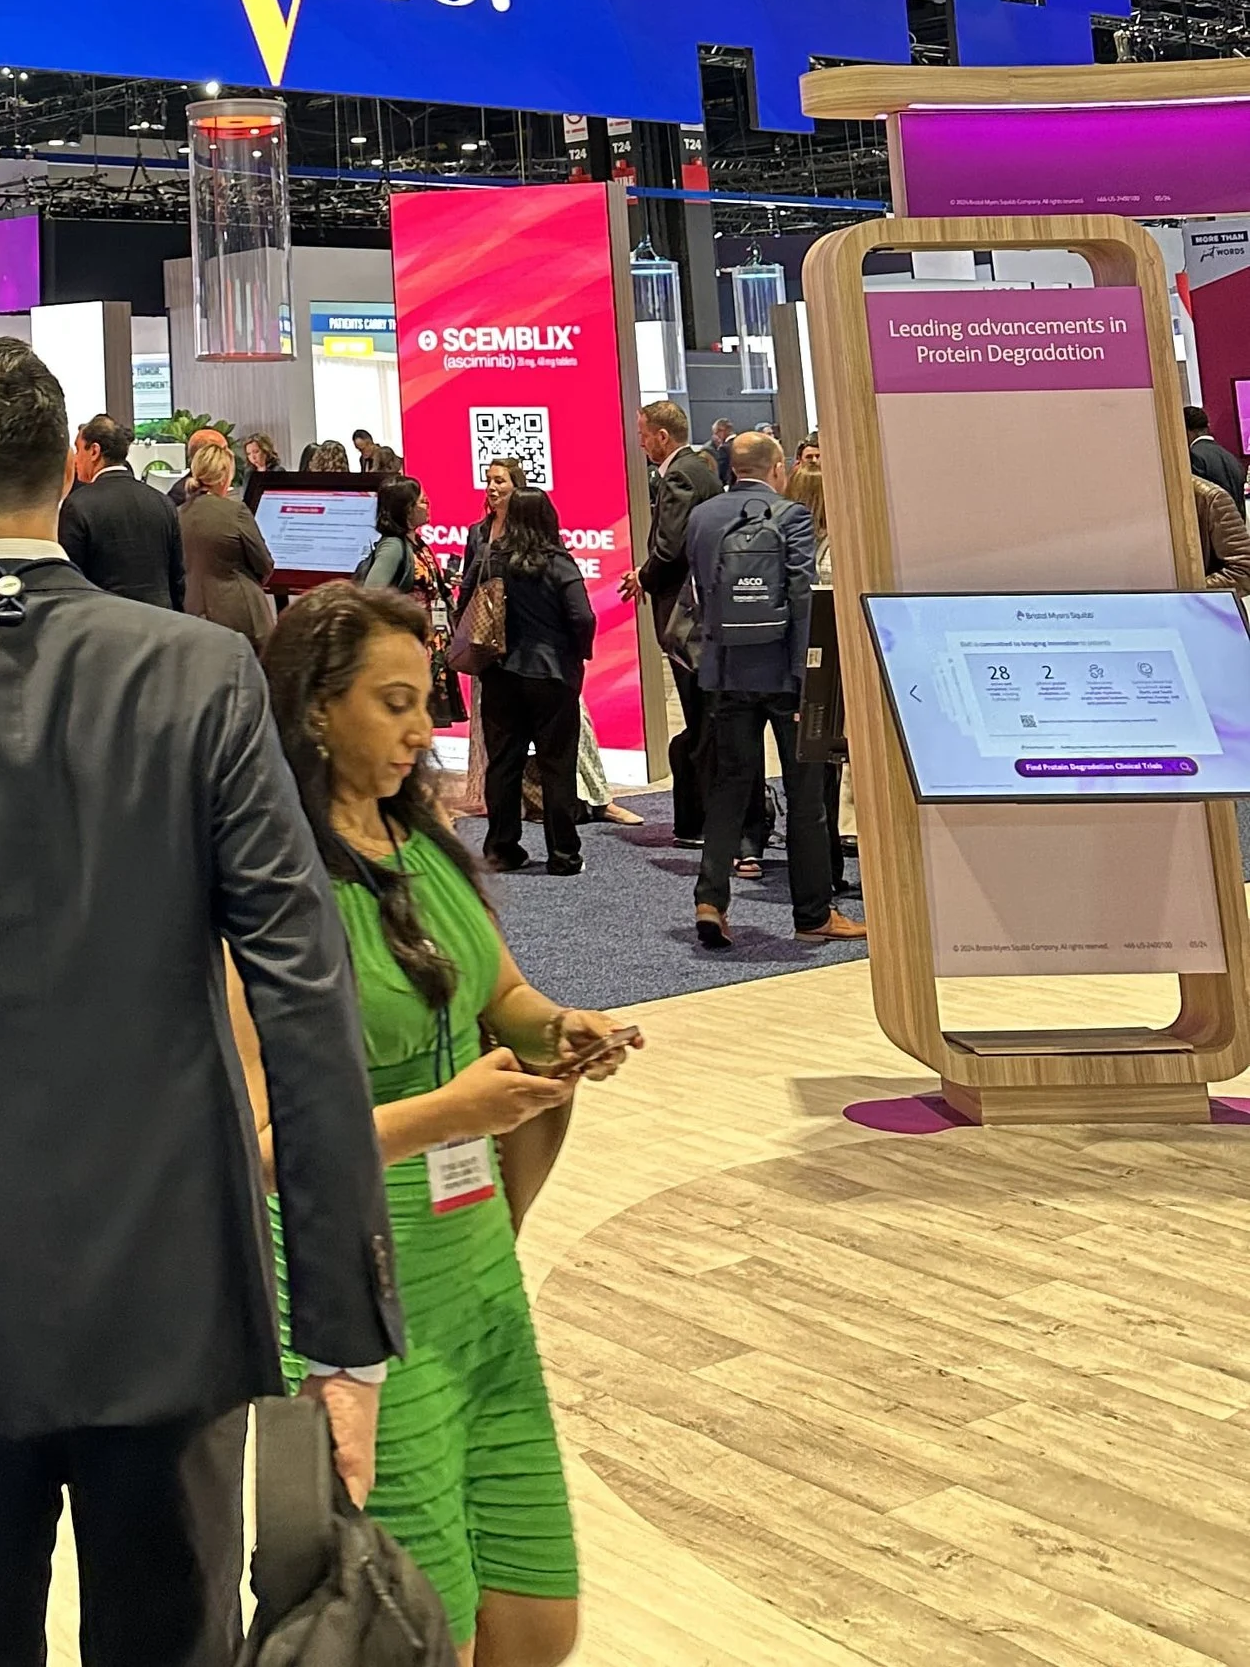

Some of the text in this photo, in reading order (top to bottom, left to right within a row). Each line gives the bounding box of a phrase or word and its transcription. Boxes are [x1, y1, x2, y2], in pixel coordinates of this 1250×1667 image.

[611, 140, 632, 154] T24
[683, 138, 702, 151] T24
[568, 148, 588, 160] T24
[1195, 233, 1244, 243] MORE THAN
[1216, 247, 1245, 256] WORDS
[889, 316, 1127, 341] Leading advancements in
[916, 343, 1105, 366] Protein Degradation
[444, 353, 516, 371] (asciminib)
[559, 529, 615, 550] CODE
[738, 577, 763, 586] ASCO
[987, 665, 1054, 680] 28 2
